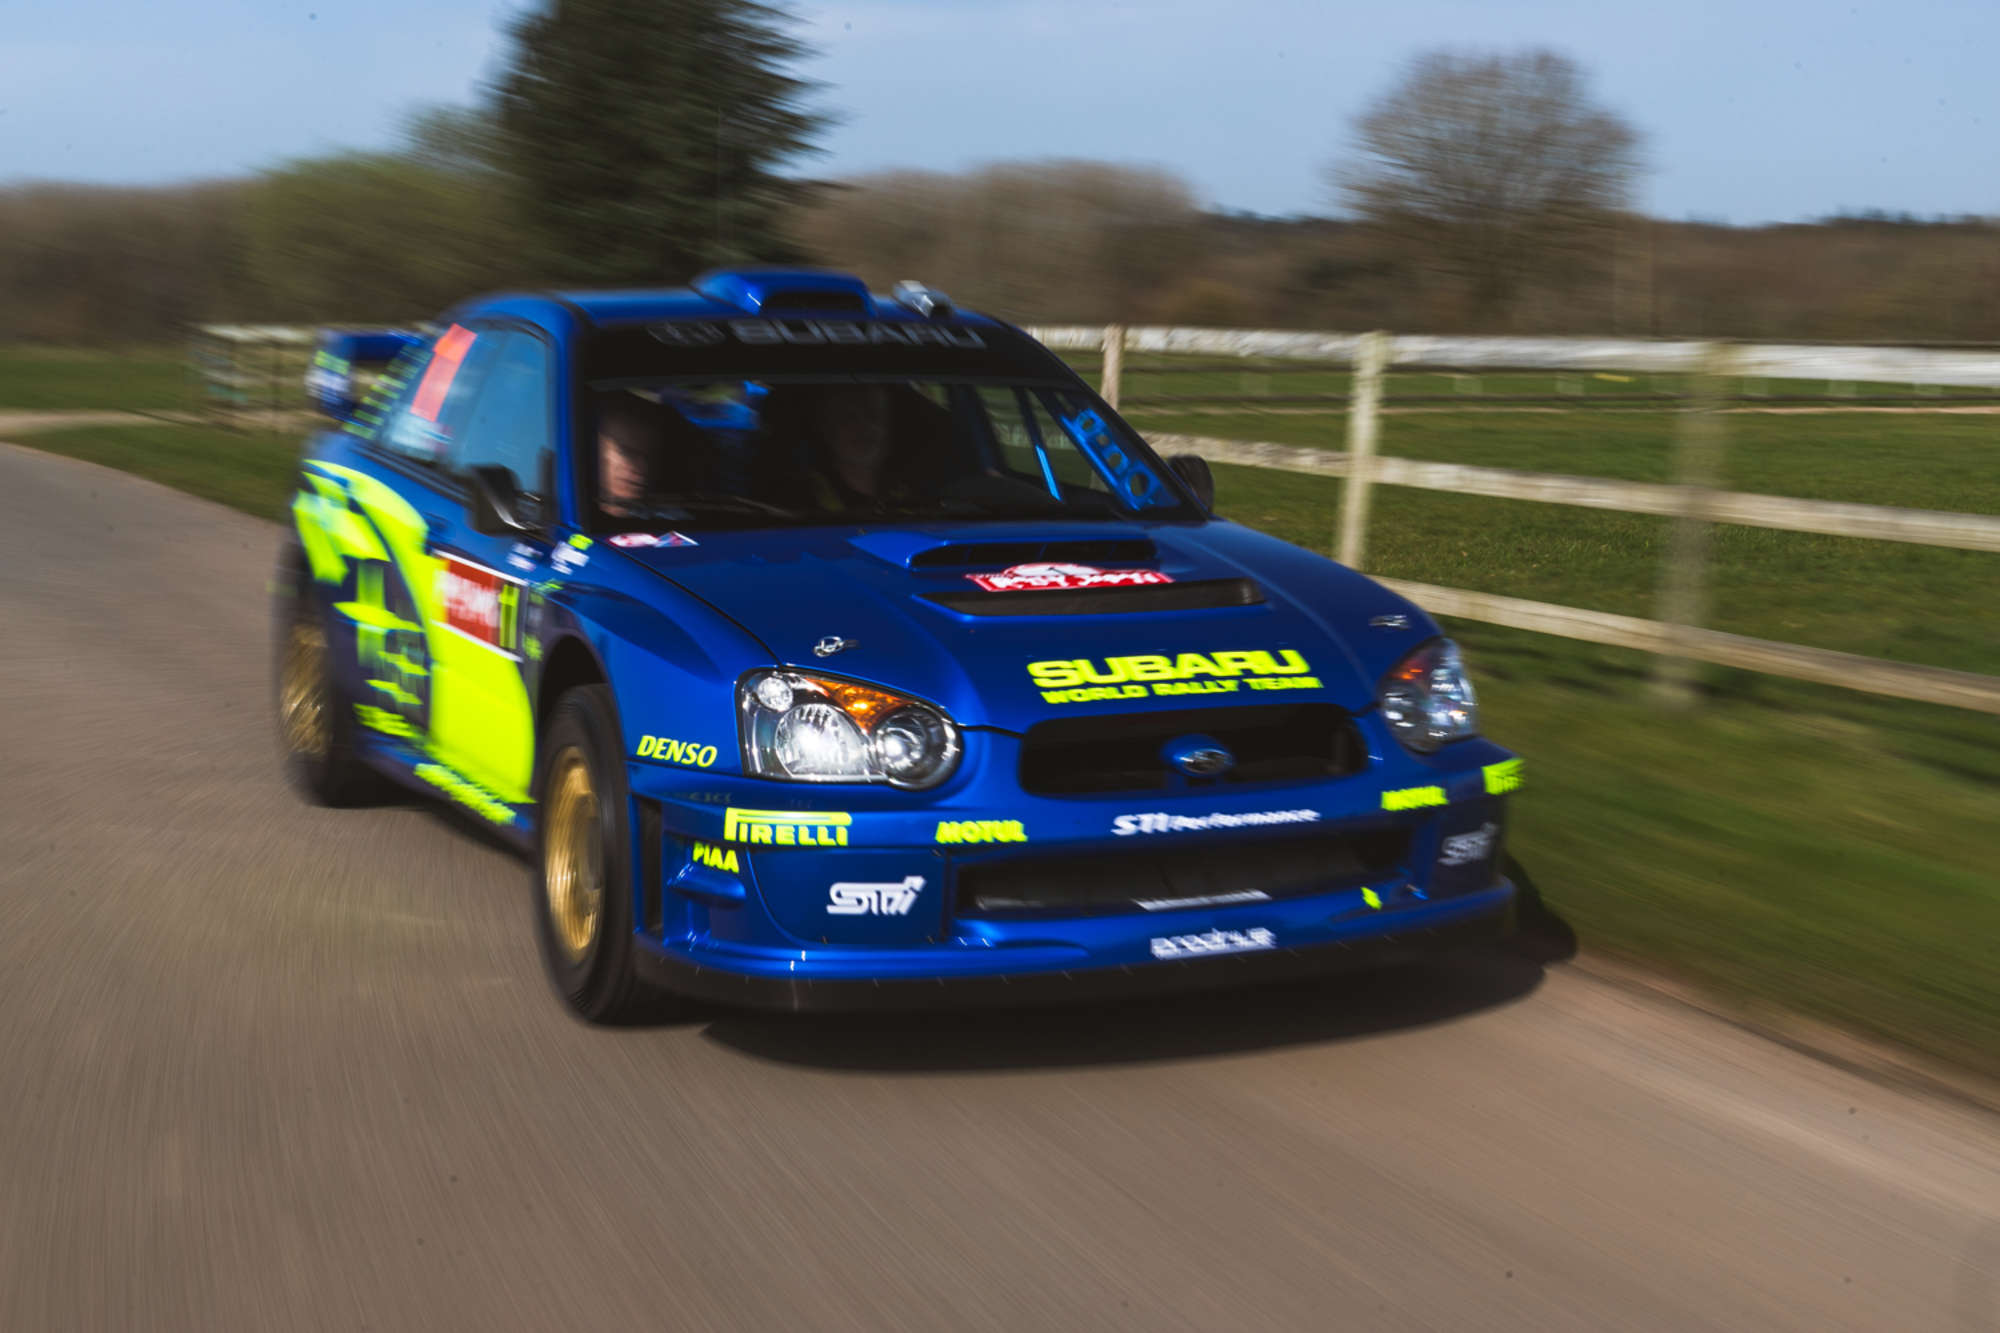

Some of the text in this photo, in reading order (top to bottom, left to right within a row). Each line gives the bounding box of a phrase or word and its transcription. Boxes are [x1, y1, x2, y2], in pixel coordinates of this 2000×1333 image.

[728, 318, 988, 348] SUBARU
[1027, 650, 1310, 687] SUBARU
[1040, 676, 1324, 704] WORLD RALLY TEAM
[636, 735, 718, 768] DENSO
[724, 807, 853, 847] PIRELLI
[935, 819, 1028, 844] MOTUL
[693, 842, 740, 874] PIAA
